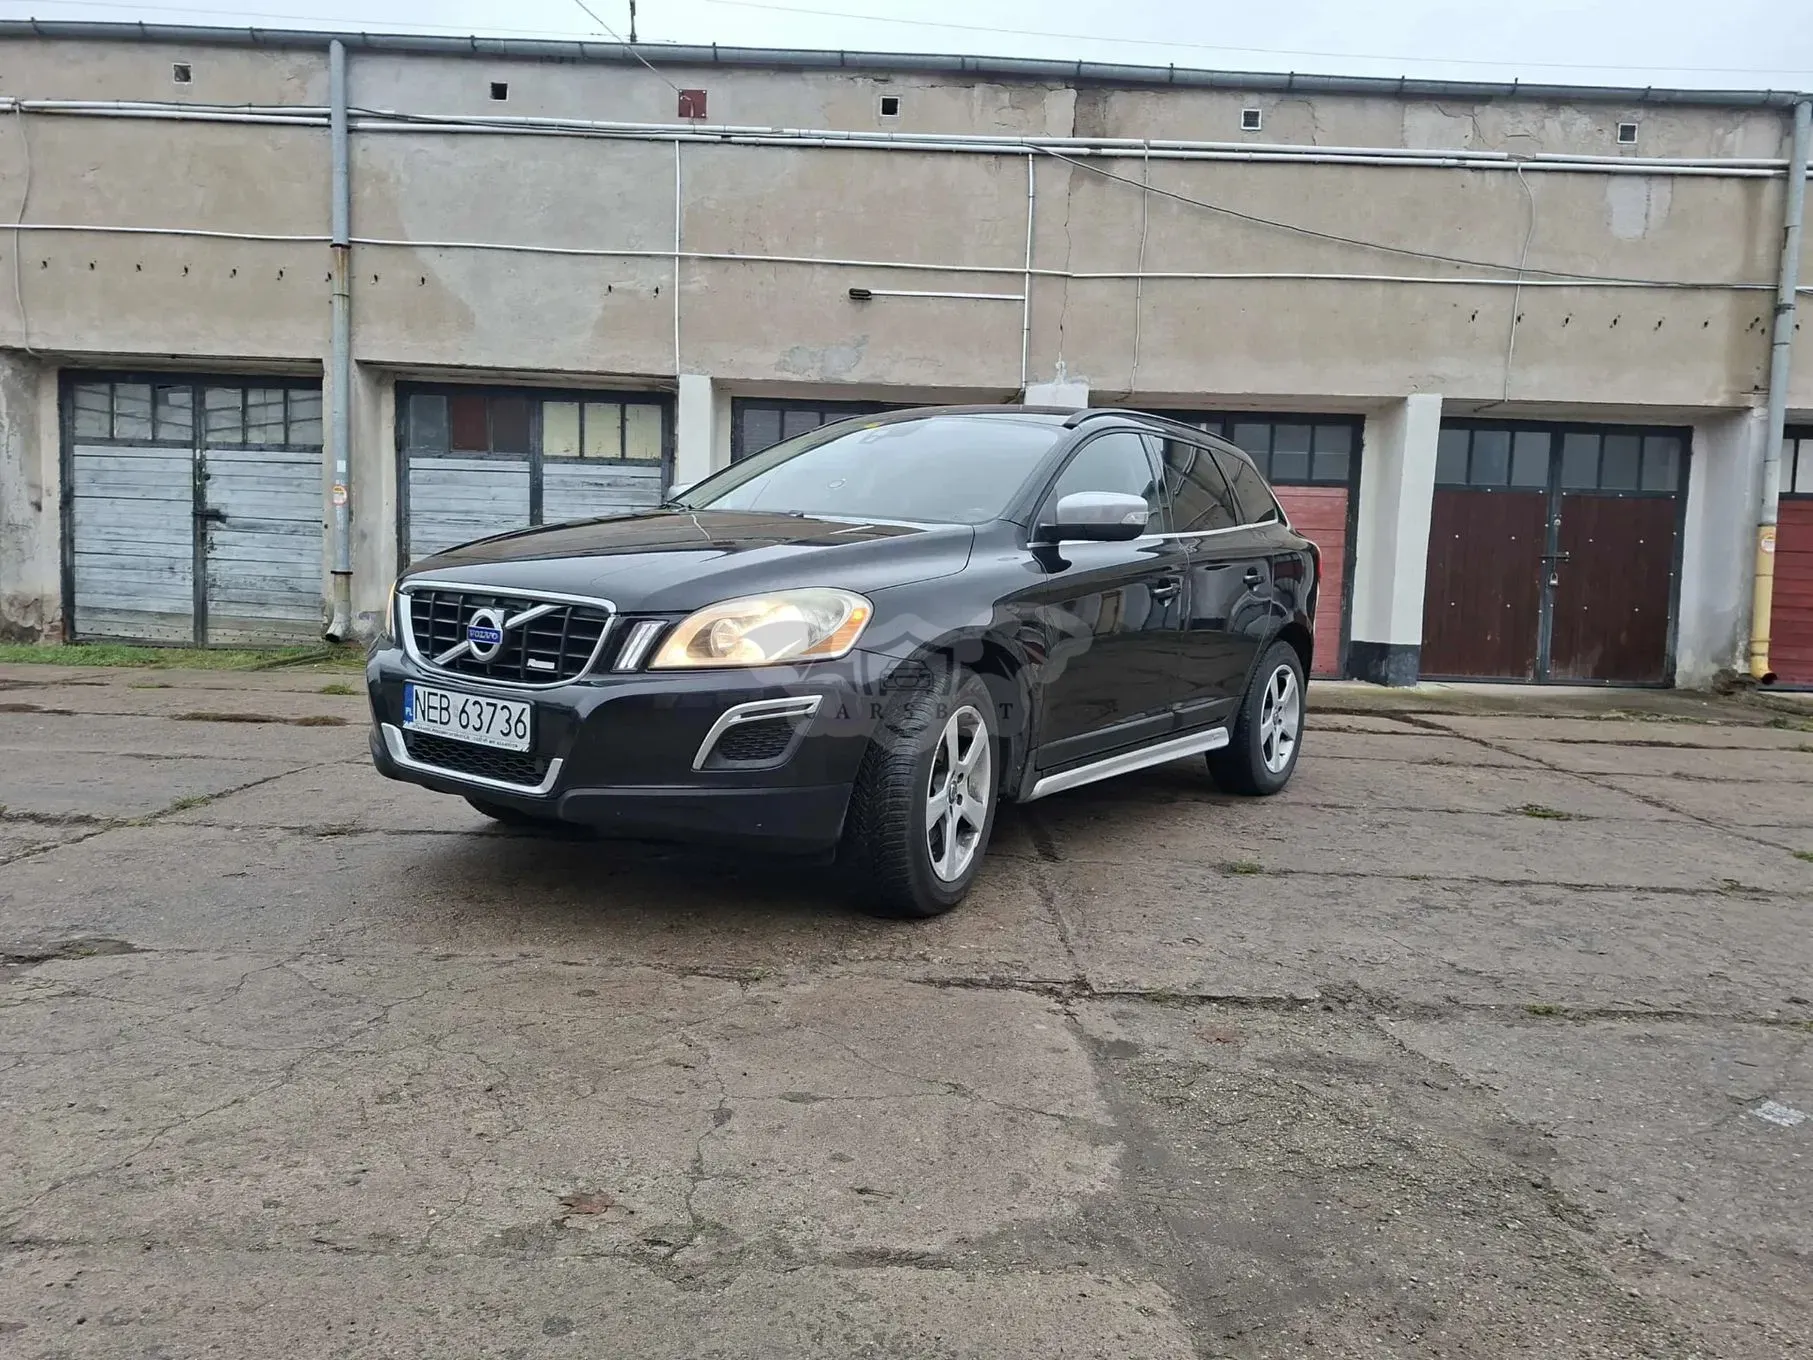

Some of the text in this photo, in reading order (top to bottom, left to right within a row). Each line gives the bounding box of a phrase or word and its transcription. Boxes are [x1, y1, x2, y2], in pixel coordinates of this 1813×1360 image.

[469, 629, 499, 640] VOLVO
[414, 688, 451, 726] NEB
[459, 698, 527, 740] 63736
